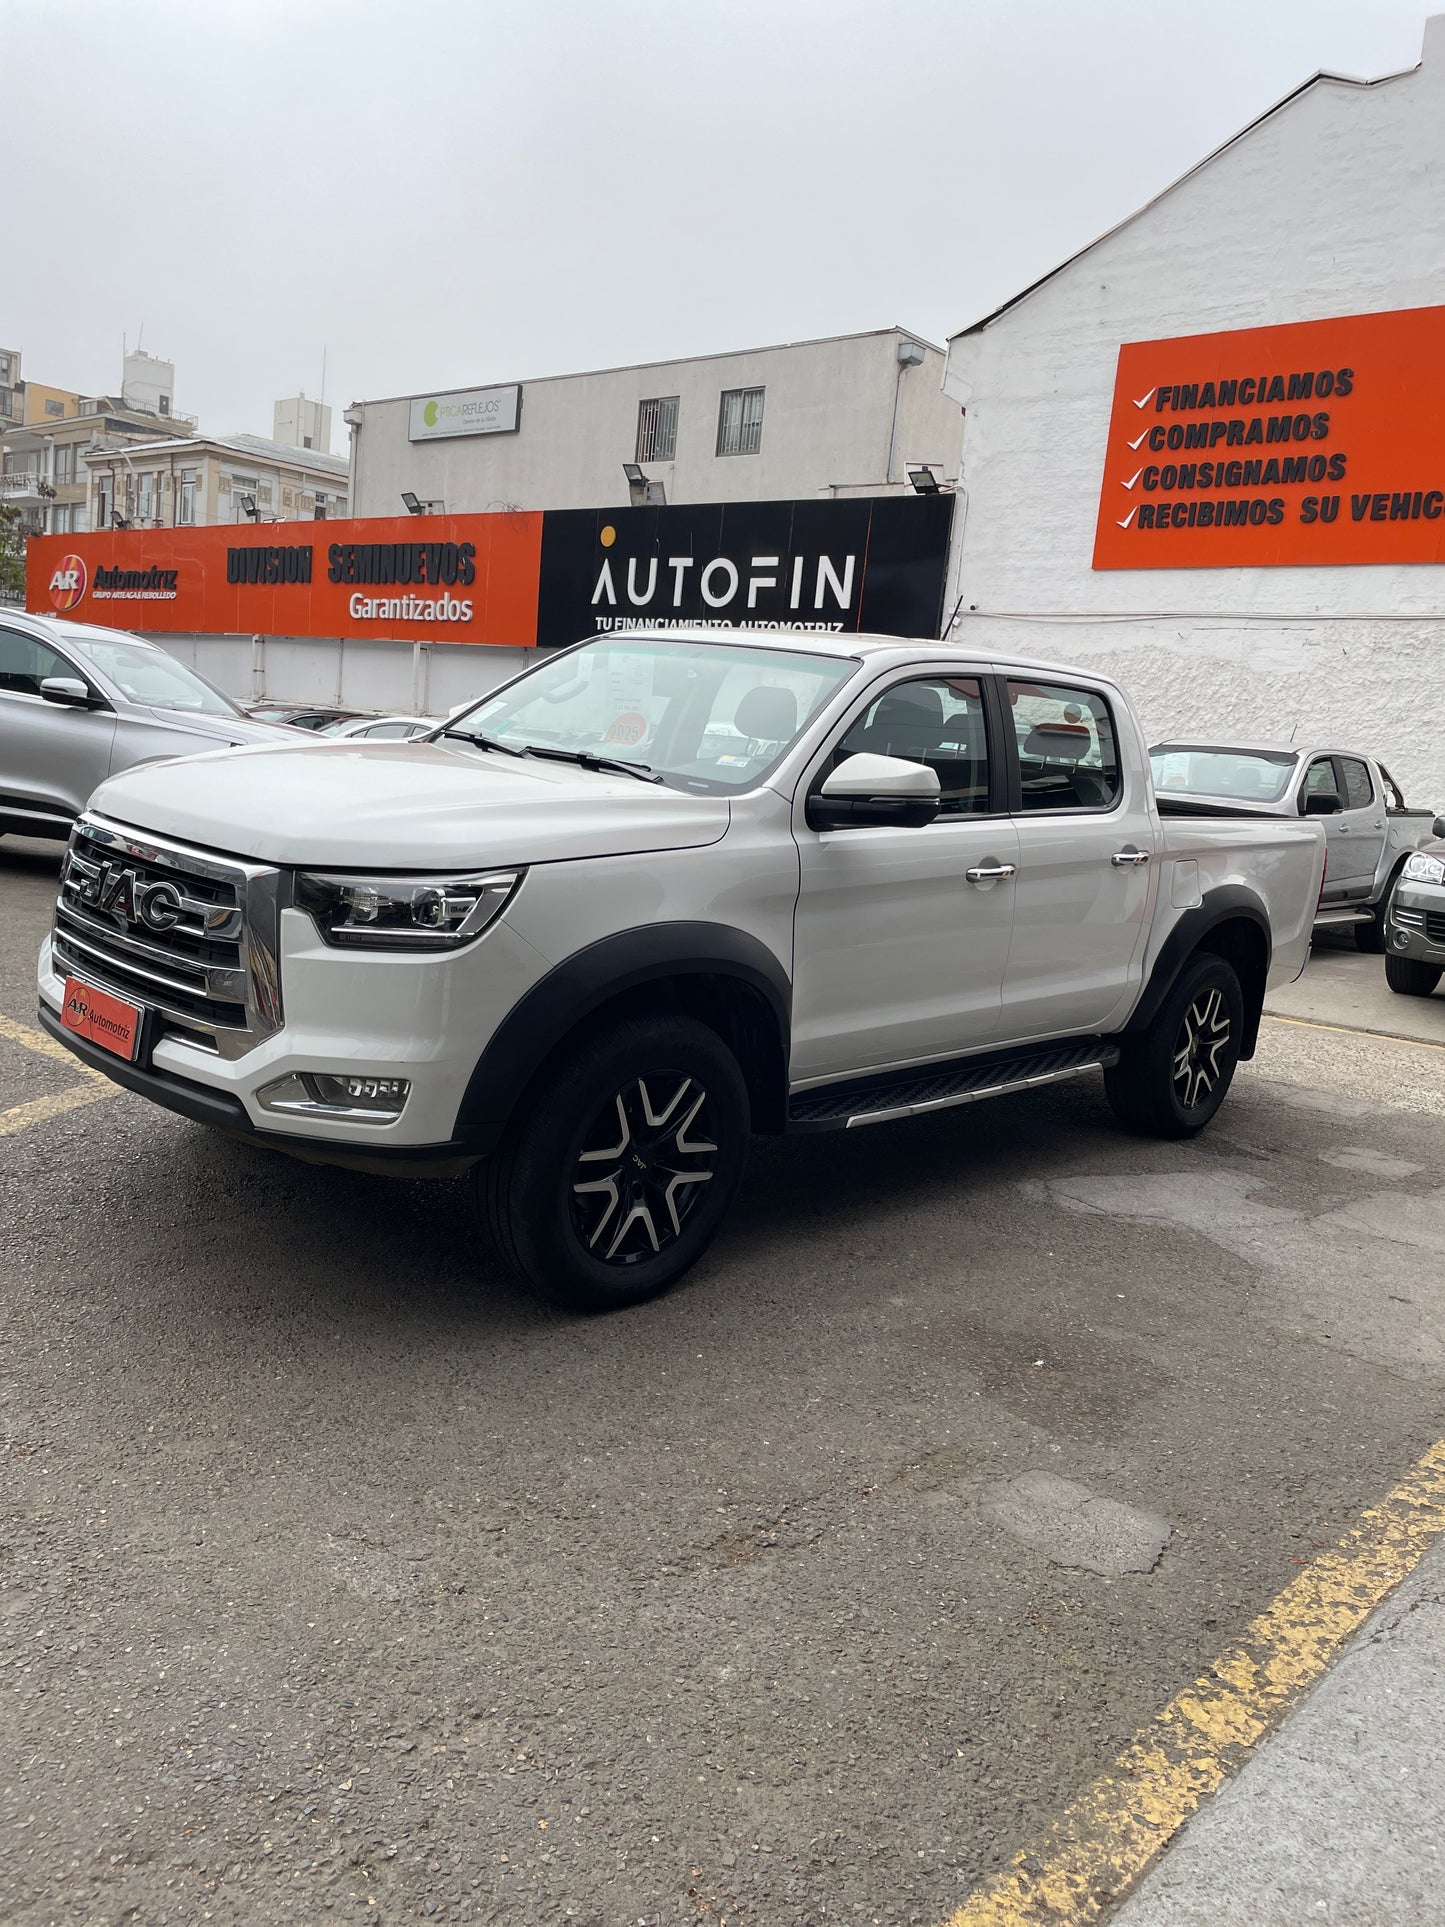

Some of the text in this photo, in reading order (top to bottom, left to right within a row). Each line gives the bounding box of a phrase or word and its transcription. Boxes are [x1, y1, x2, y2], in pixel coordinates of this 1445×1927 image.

[1155, 368, 1354, 412] FINANCIAMOS
[1149, 413, 1330, 451] COMPRAMOS
[1142, 453, 1347, 491] CONSIGNAMOS
[1137, 490, 1445, 529] RECIBIMOS SU VEHIC
[93, 565, 177, 589] Automotriz
[227, 542, 475, 585] DIVISION SEMINUEVOS
[591, 555, 856, 609] AUTOFIN
[92, 591, 111, 599] GRUPO
[141, 591, 177, 600] REBOLLEDO
[349, 592, 473, 622] Garantizados
[595, 616, 612, 631] TU
[614, 617, 733, 631] FINANCIAMIENTO
[609, 724, 639, 741] 2025
[80, 861, 181, 931] JAC
[88, 1009, 130, 1039] Automotriz
